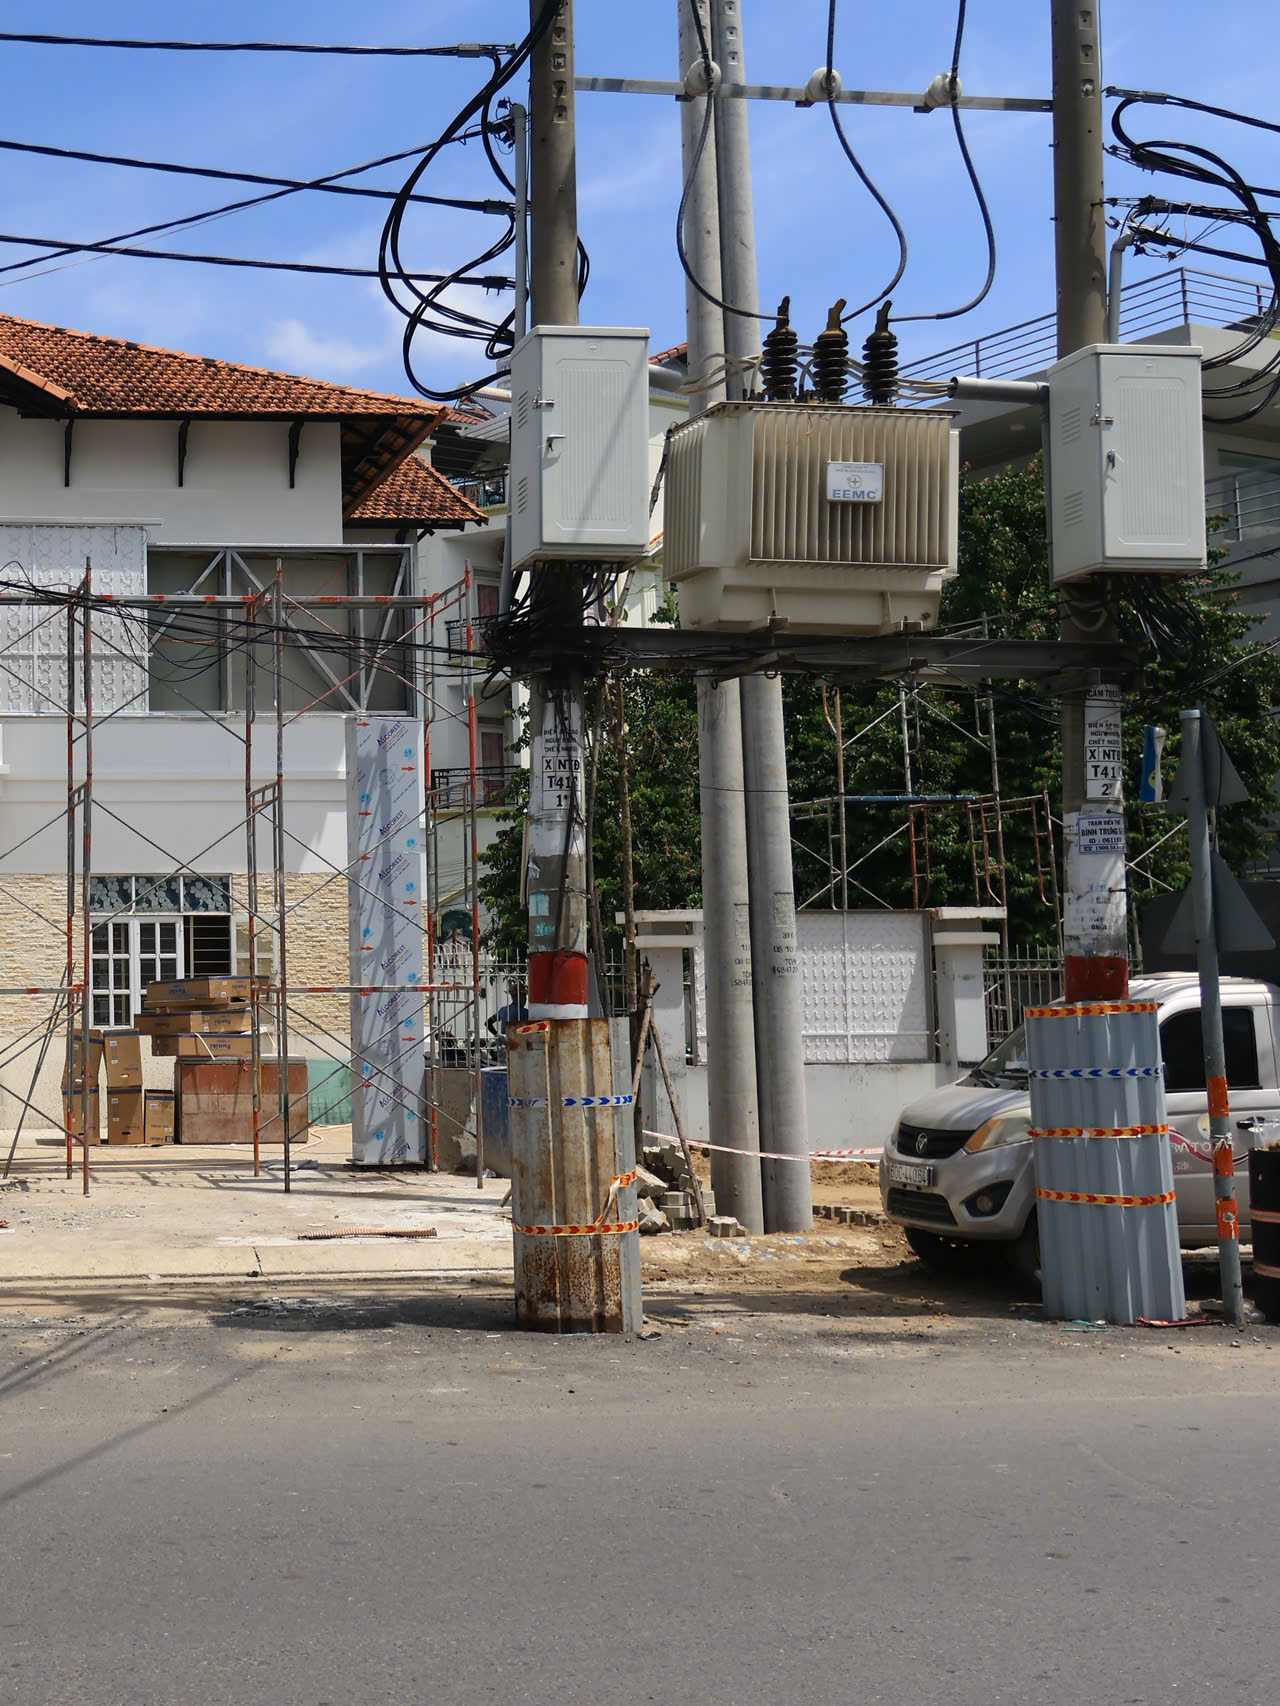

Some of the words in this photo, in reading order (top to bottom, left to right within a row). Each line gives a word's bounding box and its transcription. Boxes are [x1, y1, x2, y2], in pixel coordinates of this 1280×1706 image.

[832, 488, 877, 500] EEMC
[1088, 749, 1096, 760] X
[545, 759, 553, 771] X
[547, 775, 578, 789] T41
